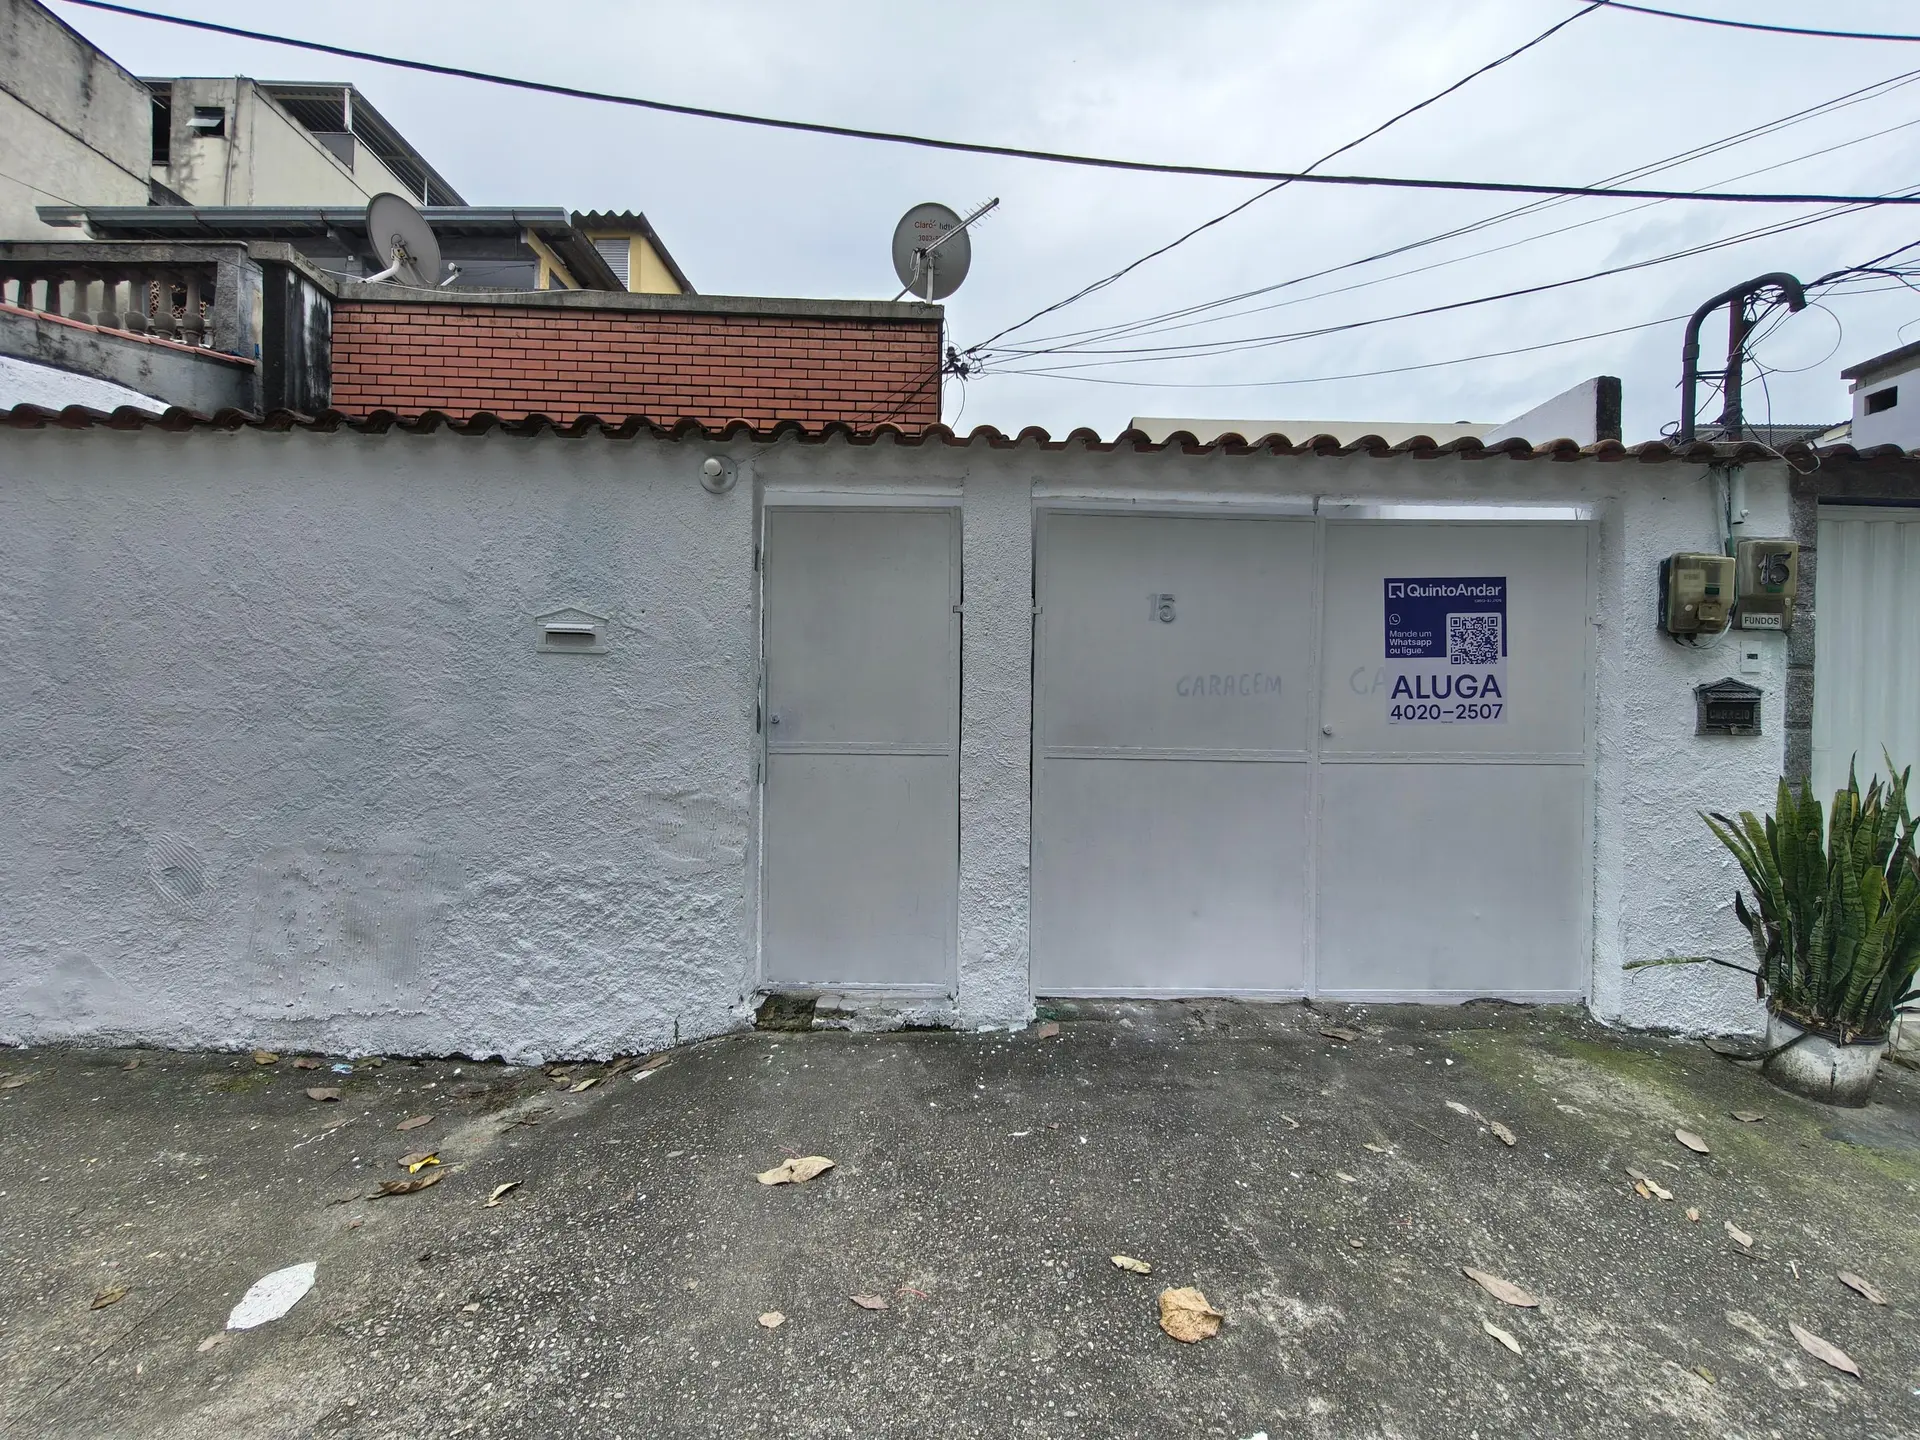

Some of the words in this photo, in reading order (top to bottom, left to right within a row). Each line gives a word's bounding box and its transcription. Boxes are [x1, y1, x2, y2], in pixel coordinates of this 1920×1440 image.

[914, 221, 934, 229] Claro
[1757, 551, 1792, 586] 15
[1407, 583, 1502, 598] QuintoAndar
[1146, 593, 1177, 623] 15
[1744, 616, 1780, 626] FUNDOS
[1389, 630, 1418, 638] Mande
[1389, 638, 1432, 647] Whatsapp
[1401, 647, 1425, 656] ligue.
[1176, 673, 1283, 698] GARAGEM
[1391, 674, 1502, 700] ALUGA
[1390, 703, 1503, 720] 4020-2507
